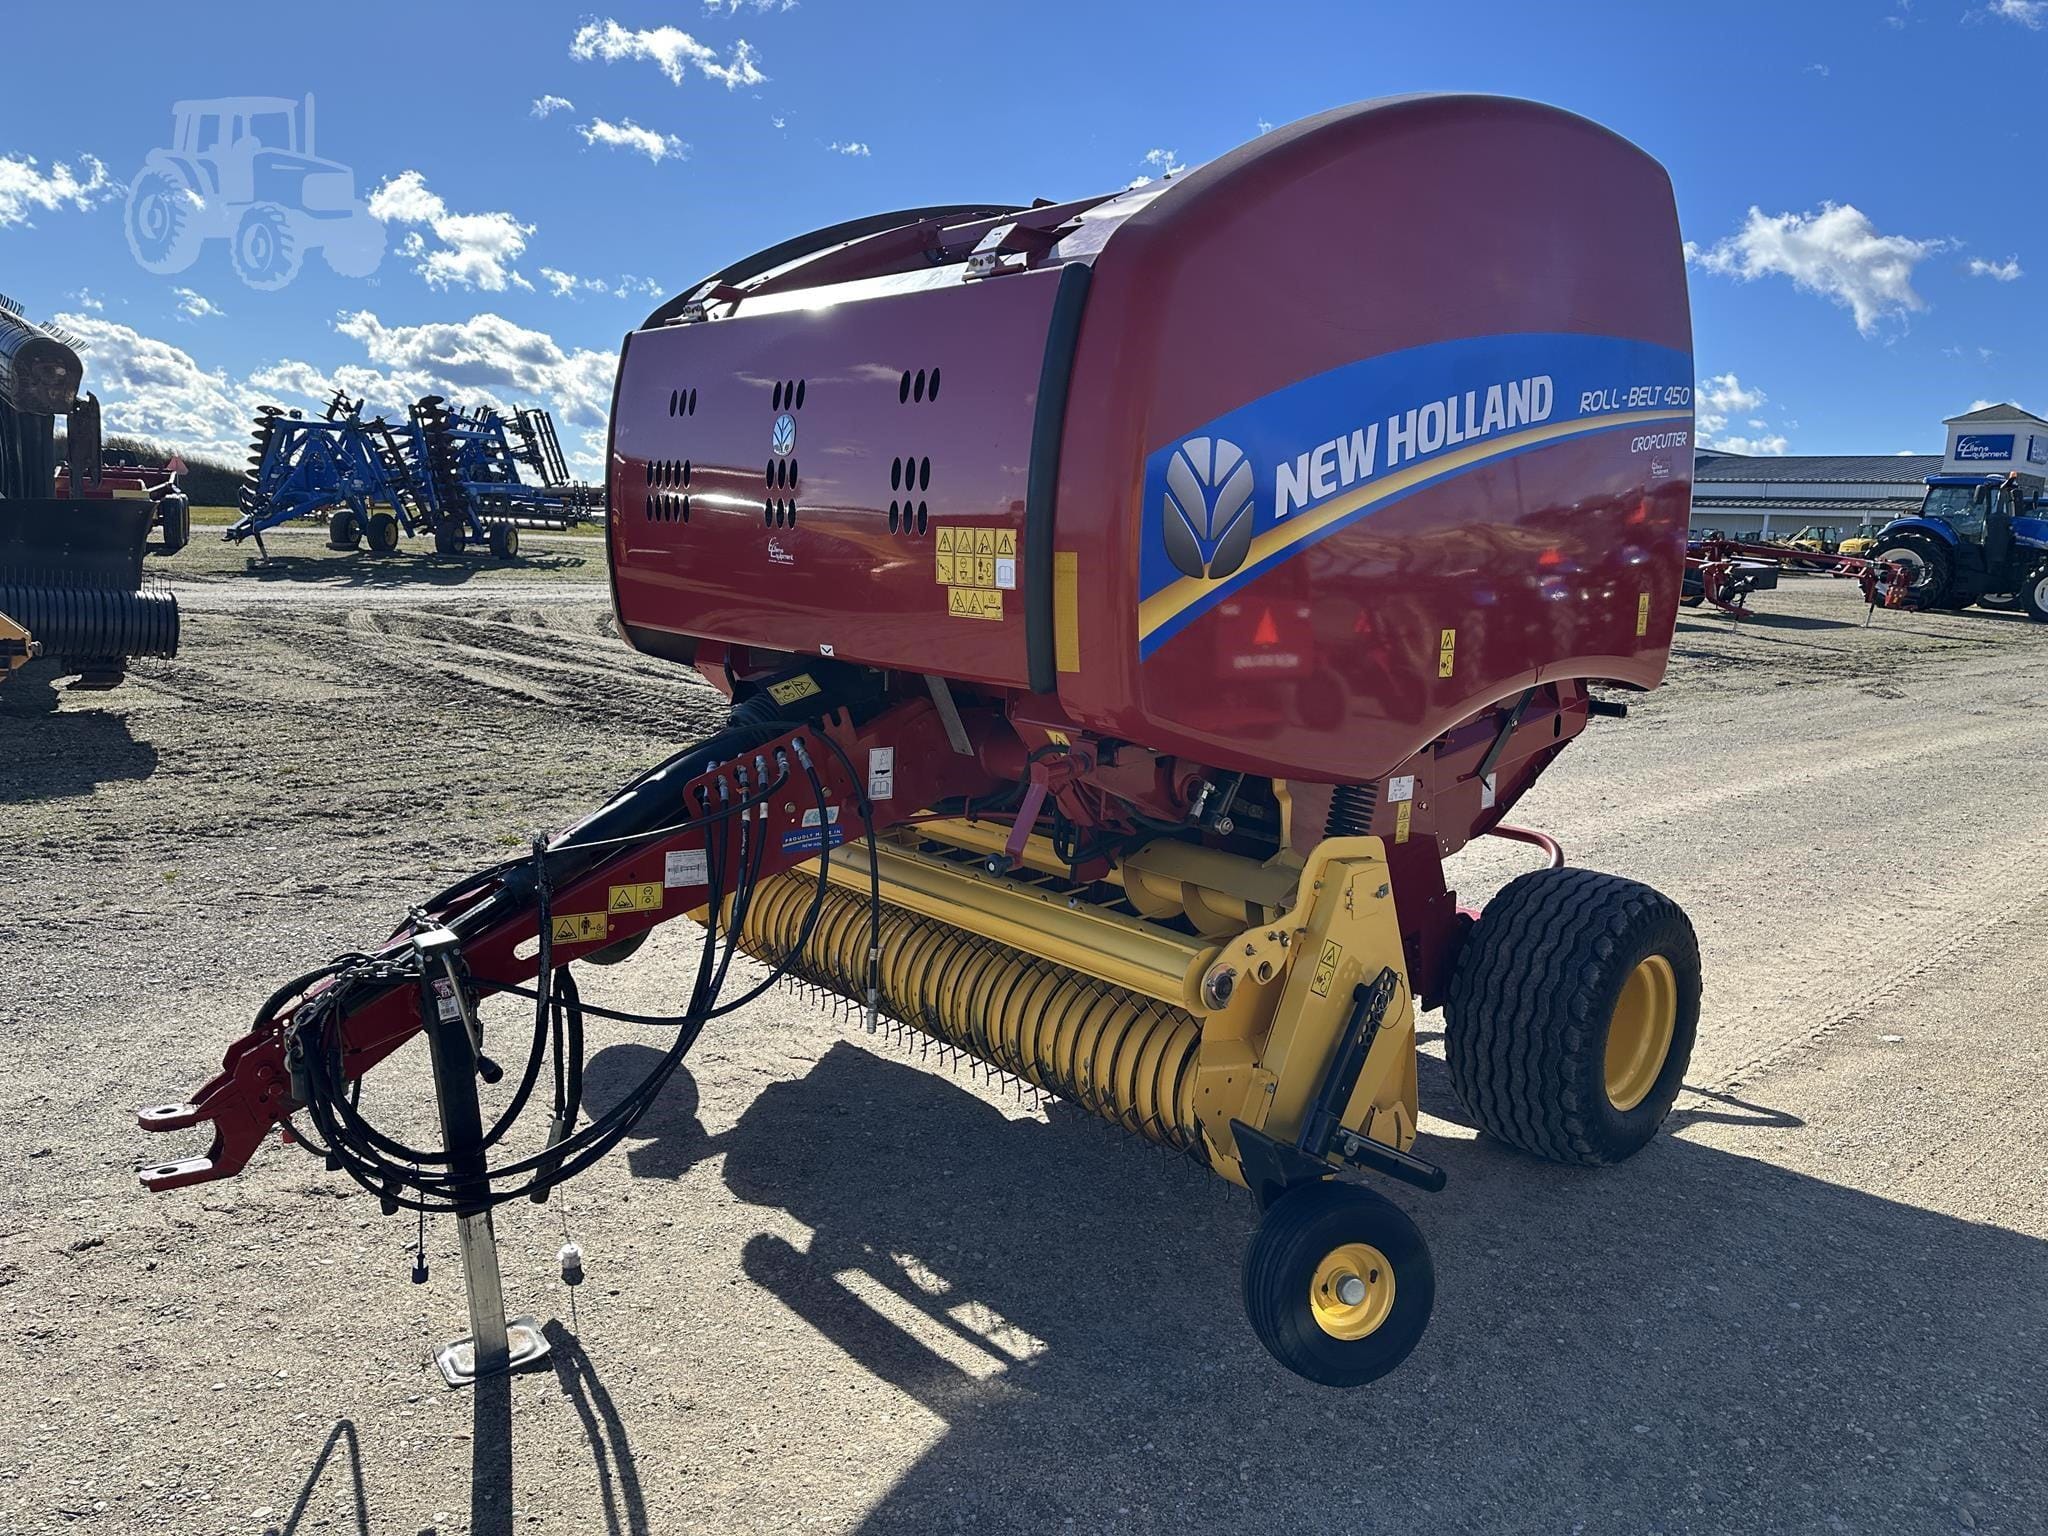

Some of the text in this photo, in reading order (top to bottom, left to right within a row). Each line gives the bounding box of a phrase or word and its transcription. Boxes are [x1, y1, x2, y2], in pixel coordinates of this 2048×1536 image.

[1579, 386, 1690, 414] ROLL-BELT 450
[1274, 374, 1554, 519] NEW HOLLAND
[1631, 431, 1688, 453] CROPCUTTER
[1961, 442, 2009, 459] Equipment
[784, 833, 813, 843] PROUDLY
